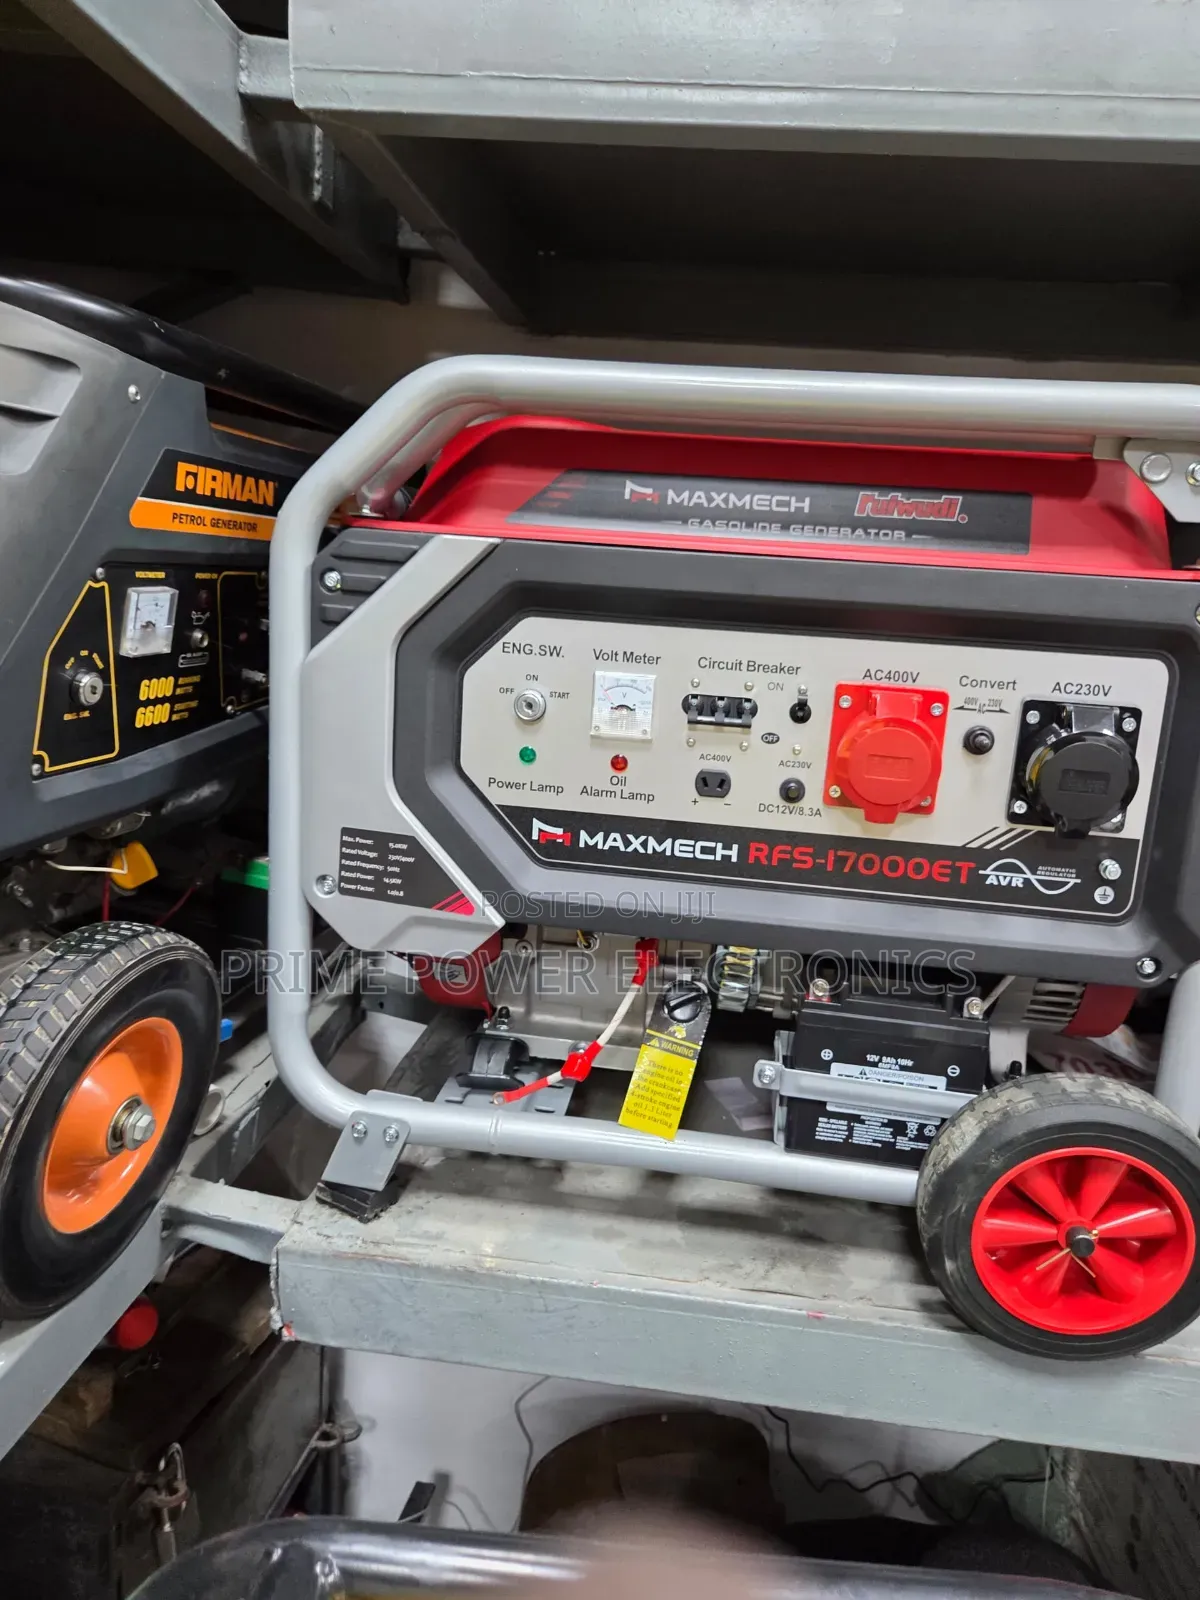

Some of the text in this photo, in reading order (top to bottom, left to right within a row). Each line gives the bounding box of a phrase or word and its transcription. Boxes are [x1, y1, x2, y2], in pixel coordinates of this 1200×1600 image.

[175, 461, 275, 507] FIRMAN
[666, 488, 811, 513] MAXMECH
[172, 512, 258, 533] PETROL GENERATOR
[687, 518, 906, 542] GASOLINE GENERATOR
[501, 641, 565, 658] ENG.SW.
[592, 648, 661, 666] Volt Meter
[697, 656, 801, 675] Circuit Breaker
[525, 673, 539, 682] ON
[862, 668, 920, 684] AC400V
[958, 675, 1018, 691] Convert
[139, 675, 175, 701] 6000
[498, 687, 515, 695] OFF
[767, 681, 784, 692] ON
[1051, 681, 1112, 697] AC230V
[549, 690, 570, 700] START
[135, 702, 171, 728] 6600
[762, 734, 779, 743] OFF
[699, 753, 732, 763] AC400V
[778, 759, 812, 770] AC230V
[487, 776, 564, 796] Power Lamp
[609, 774, 627, 787] Oil
[580, 785, 656, 804] Alarm Lamp
[758, 802, 823, 818] DC12V/8.3A
[341, 847, 357, 855] Rated
[578, 829, 976, 885] MAXMECH RFS-17000ET
[341, 859, 357, 867] Rated
[1037, 865, 1077, 873] AUTOMATIC
[340, 870, 357, 878] Rated
[985, 873, 1025, 888] AVR
[1036, 870, 1077, 878] REGULATOR
[340, 882, 357, 890] Power
[660, 1040, 694, 1057] WARNING
[866, 1053, 880, 1062] 12V
[648, 1060, 667, 1072] There
[635, 1083, 681, 1104] Add specified
[658, 1099, 681, 1112] engine
[625, 1107, 673, 1129] before starting
